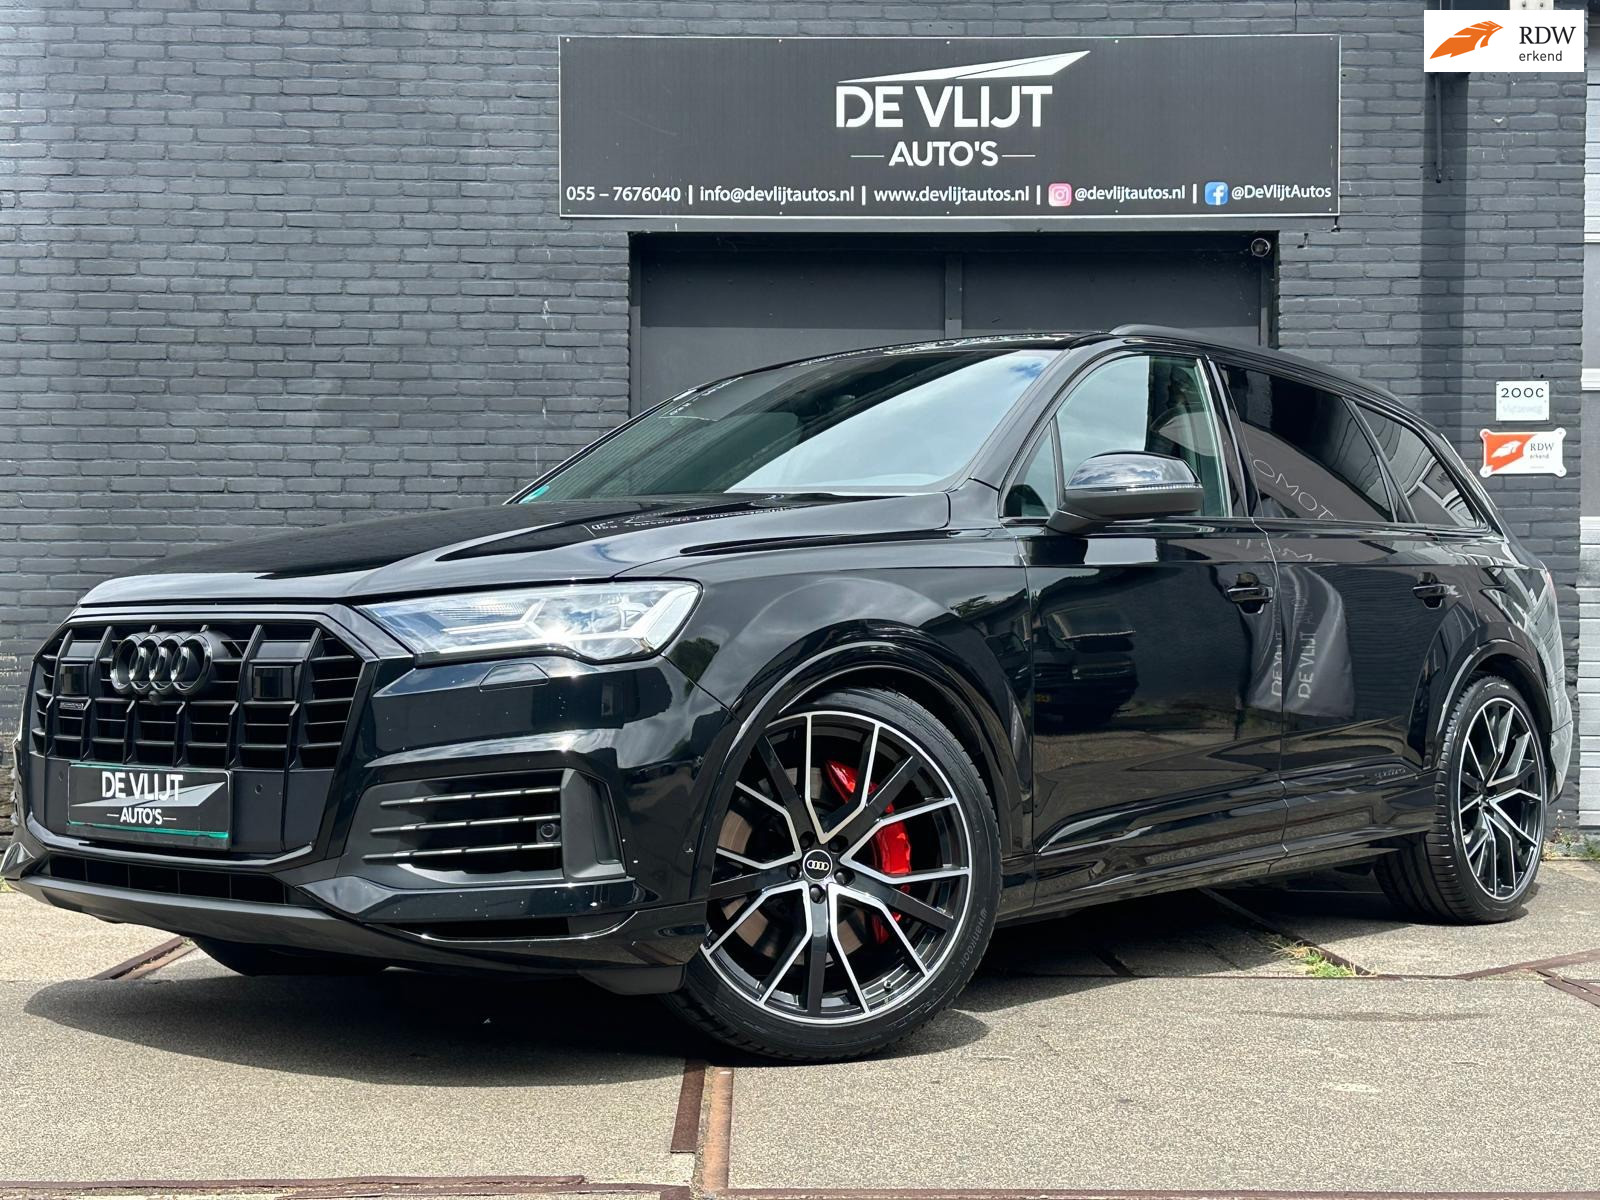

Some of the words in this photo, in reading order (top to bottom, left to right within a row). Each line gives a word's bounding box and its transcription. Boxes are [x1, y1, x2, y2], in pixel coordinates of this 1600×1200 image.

[836, 85, 904, 128] DE
[914, 85, 1053, 128] VLIJT
[888, 140, 999, 167] AUTO'S
[566, 186, 595, 201] 055
[613, 186, 681, 202] 7676040
[700, 185, 855, 205] info@devlijtautos.nl
[874, 185, 1030, 205] www.devlijtautos.nl
[1074, 184, 1186, 205] @devlijtautos.nl
[1231, 184, 1332, 202] @DeVlijtAutos
[1529, 442, 1555, 451] RDW
[101, 770, 126, 799] DE
[129, 773, 184, 801] VLIJT
[120, 807, 164, 826] AUTO'S
